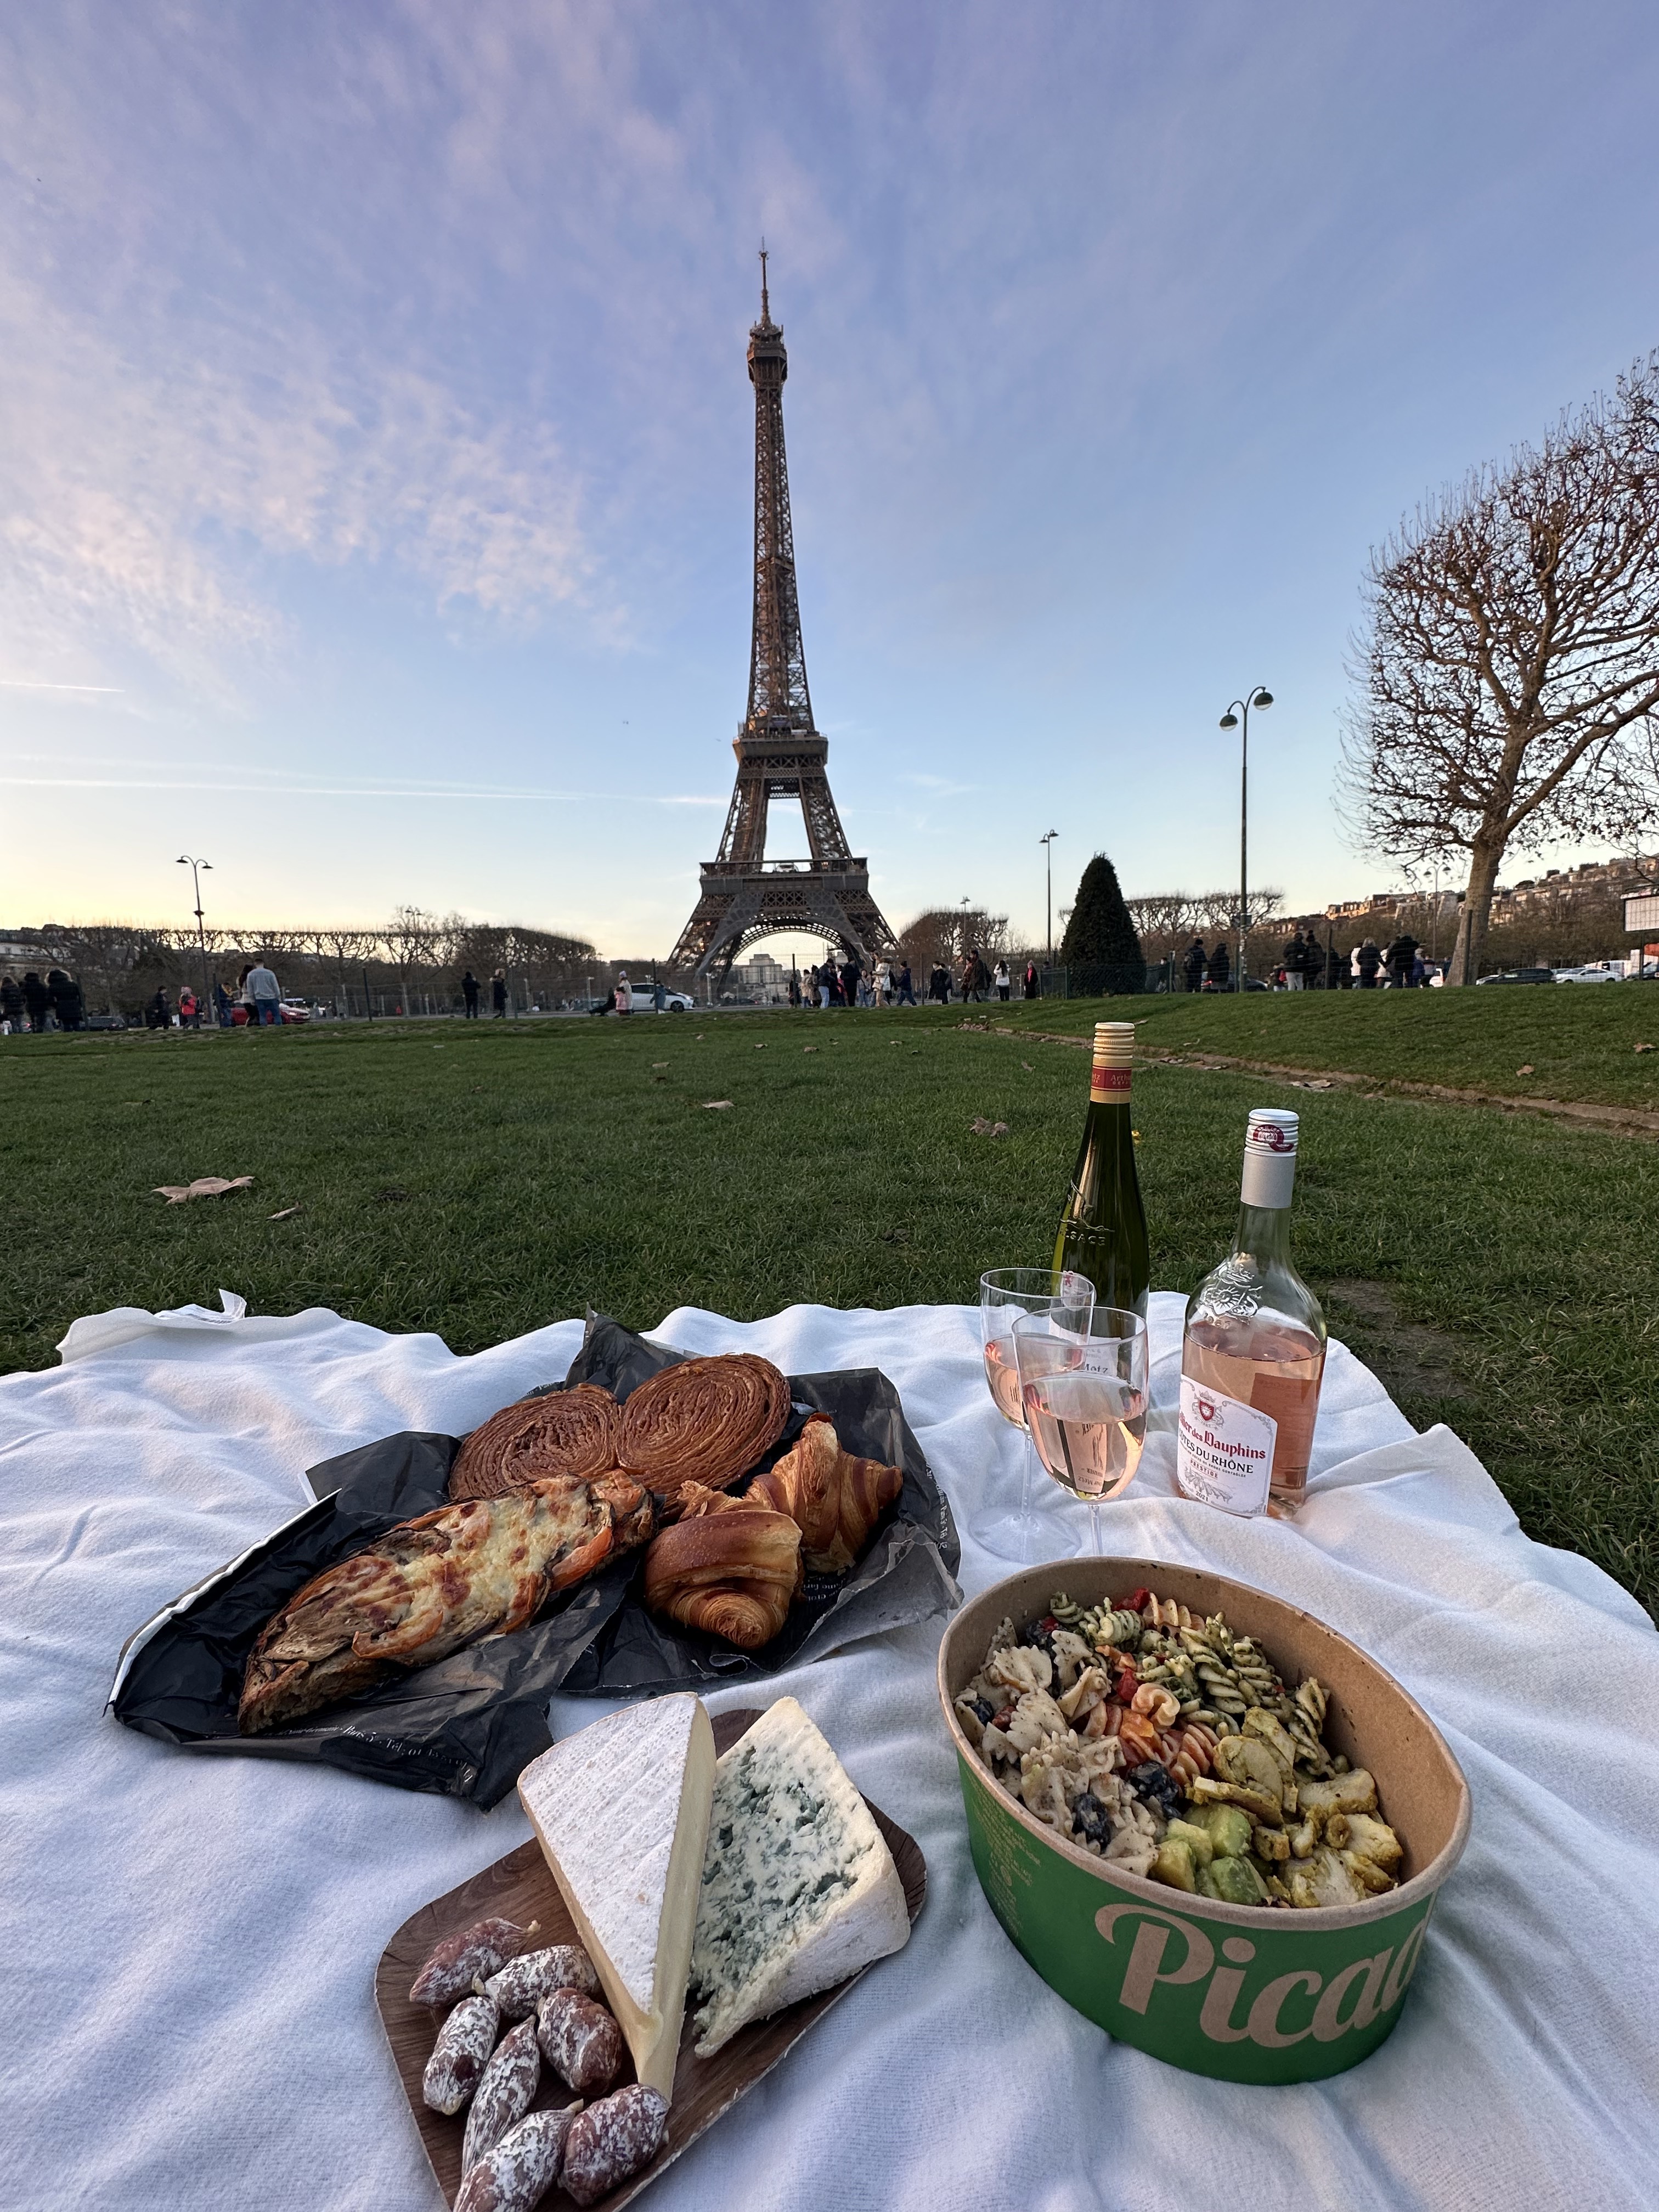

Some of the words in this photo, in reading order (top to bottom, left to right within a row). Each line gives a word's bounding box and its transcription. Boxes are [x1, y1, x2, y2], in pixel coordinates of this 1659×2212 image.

[1204, 1430, 1266, 1459] Dauphins
[1196, 1446, 1210, 1460] DU
[1211, 1454, 1254, 1474] RHÔNE
